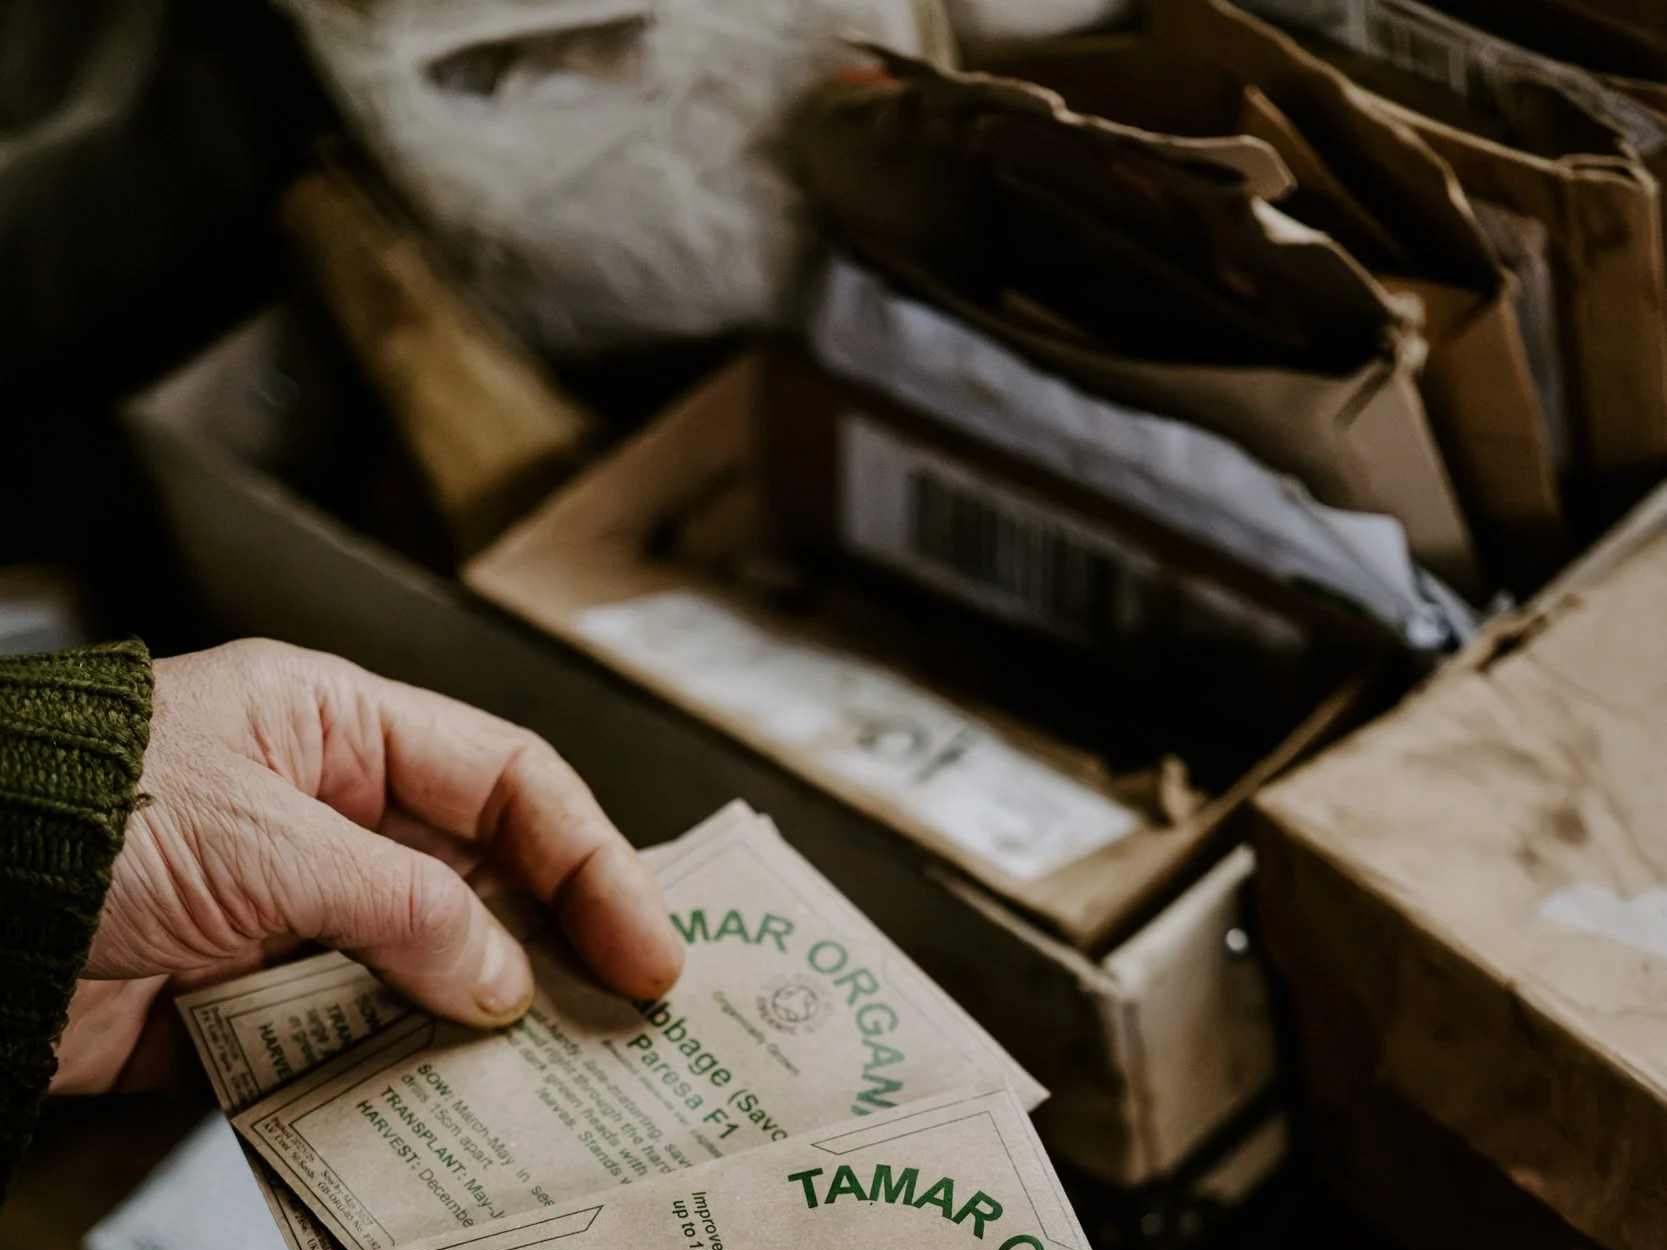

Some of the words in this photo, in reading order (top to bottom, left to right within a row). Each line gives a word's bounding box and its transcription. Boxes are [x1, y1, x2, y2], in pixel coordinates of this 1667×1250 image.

[415, 1059, 451, 1096] SOW:
[444, 1098, 515, 1166] March-May
[515, 1168, 531, 1183] in
[429, 1102, 462, 1137] 15cm
[571, 1072, 623, 1123] through
[619, 1122, 644, 1145] the
[627, 1033, 704, 1111] Paresa
[702, 1108, 740, 1140] F1
[353, 1096, 419, 1163] HARVEST:
[417, 1167, 475, 1228] Decembe
[375, 1082, 466, 1173] TRANSPLANT:
[577, 1130, 623, 1177] Stands
[580, 1107, 621, 1147] heads
[618, 1148, 648, 1177] with
[671, 1199, 689, 1219] up
[680, 1221, 698, 1238] to
[788, 1164, 1004, 1240] TAMAR
